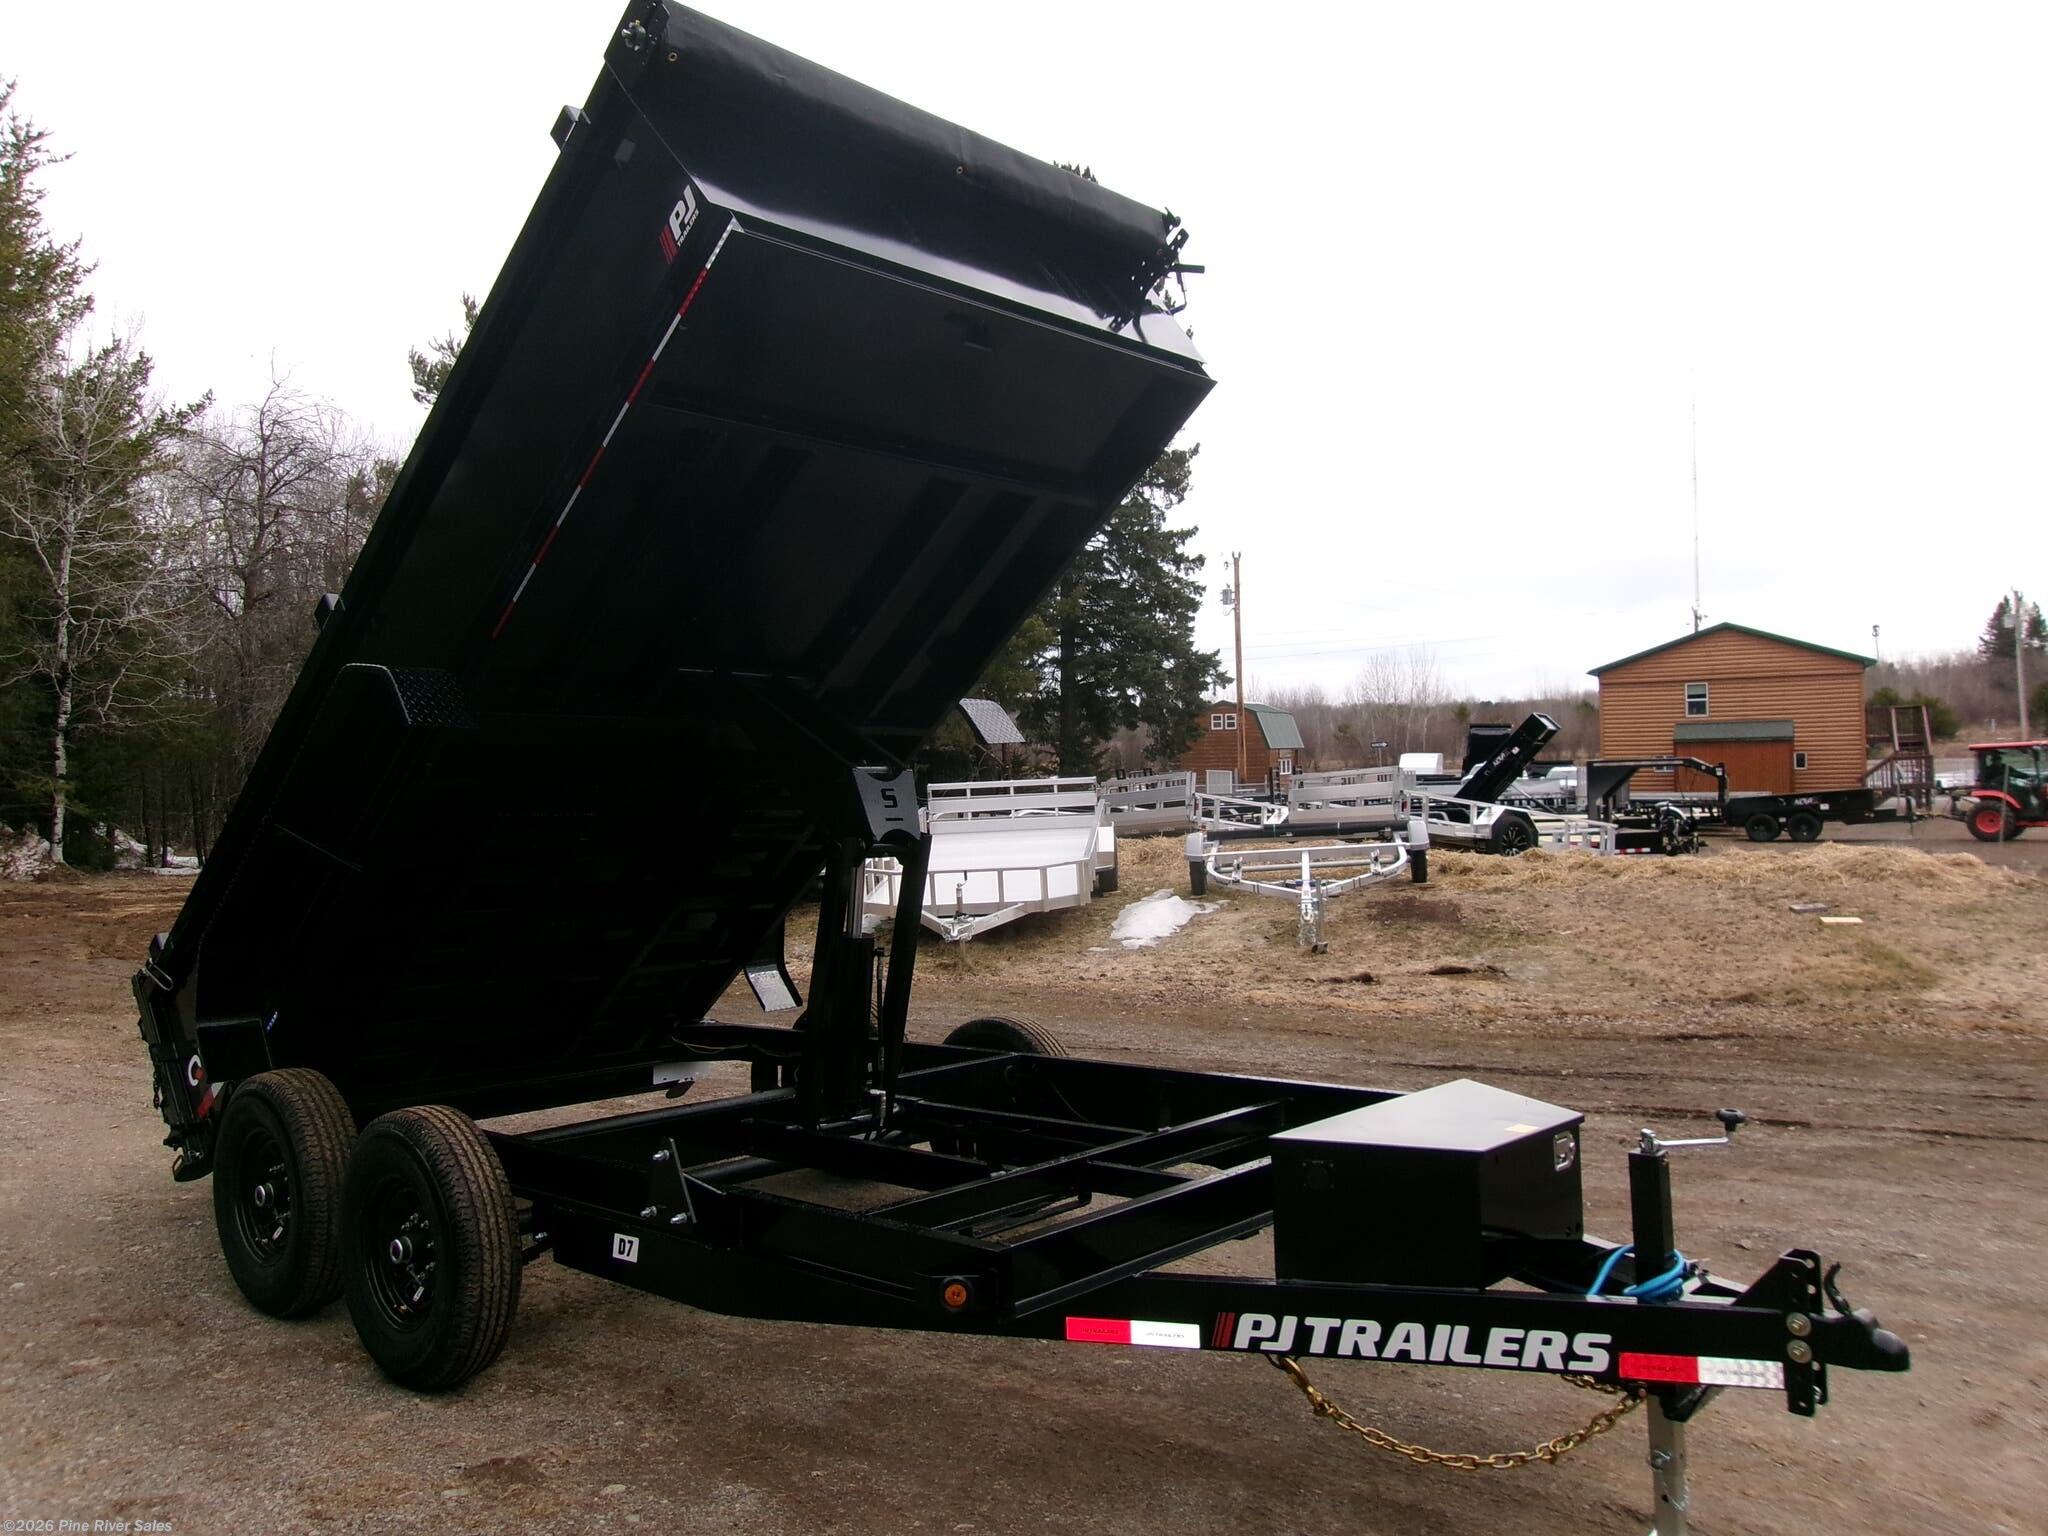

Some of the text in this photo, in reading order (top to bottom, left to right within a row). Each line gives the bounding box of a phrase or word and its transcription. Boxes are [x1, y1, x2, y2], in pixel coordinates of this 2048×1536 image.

[669, 184, 696, 242] PJ
[676, 208, 700, 247] TRAILERS
[618, 1238, 634, 1257] D7
[1233, 1312, 1612, 1372] PJ TRAILERS
